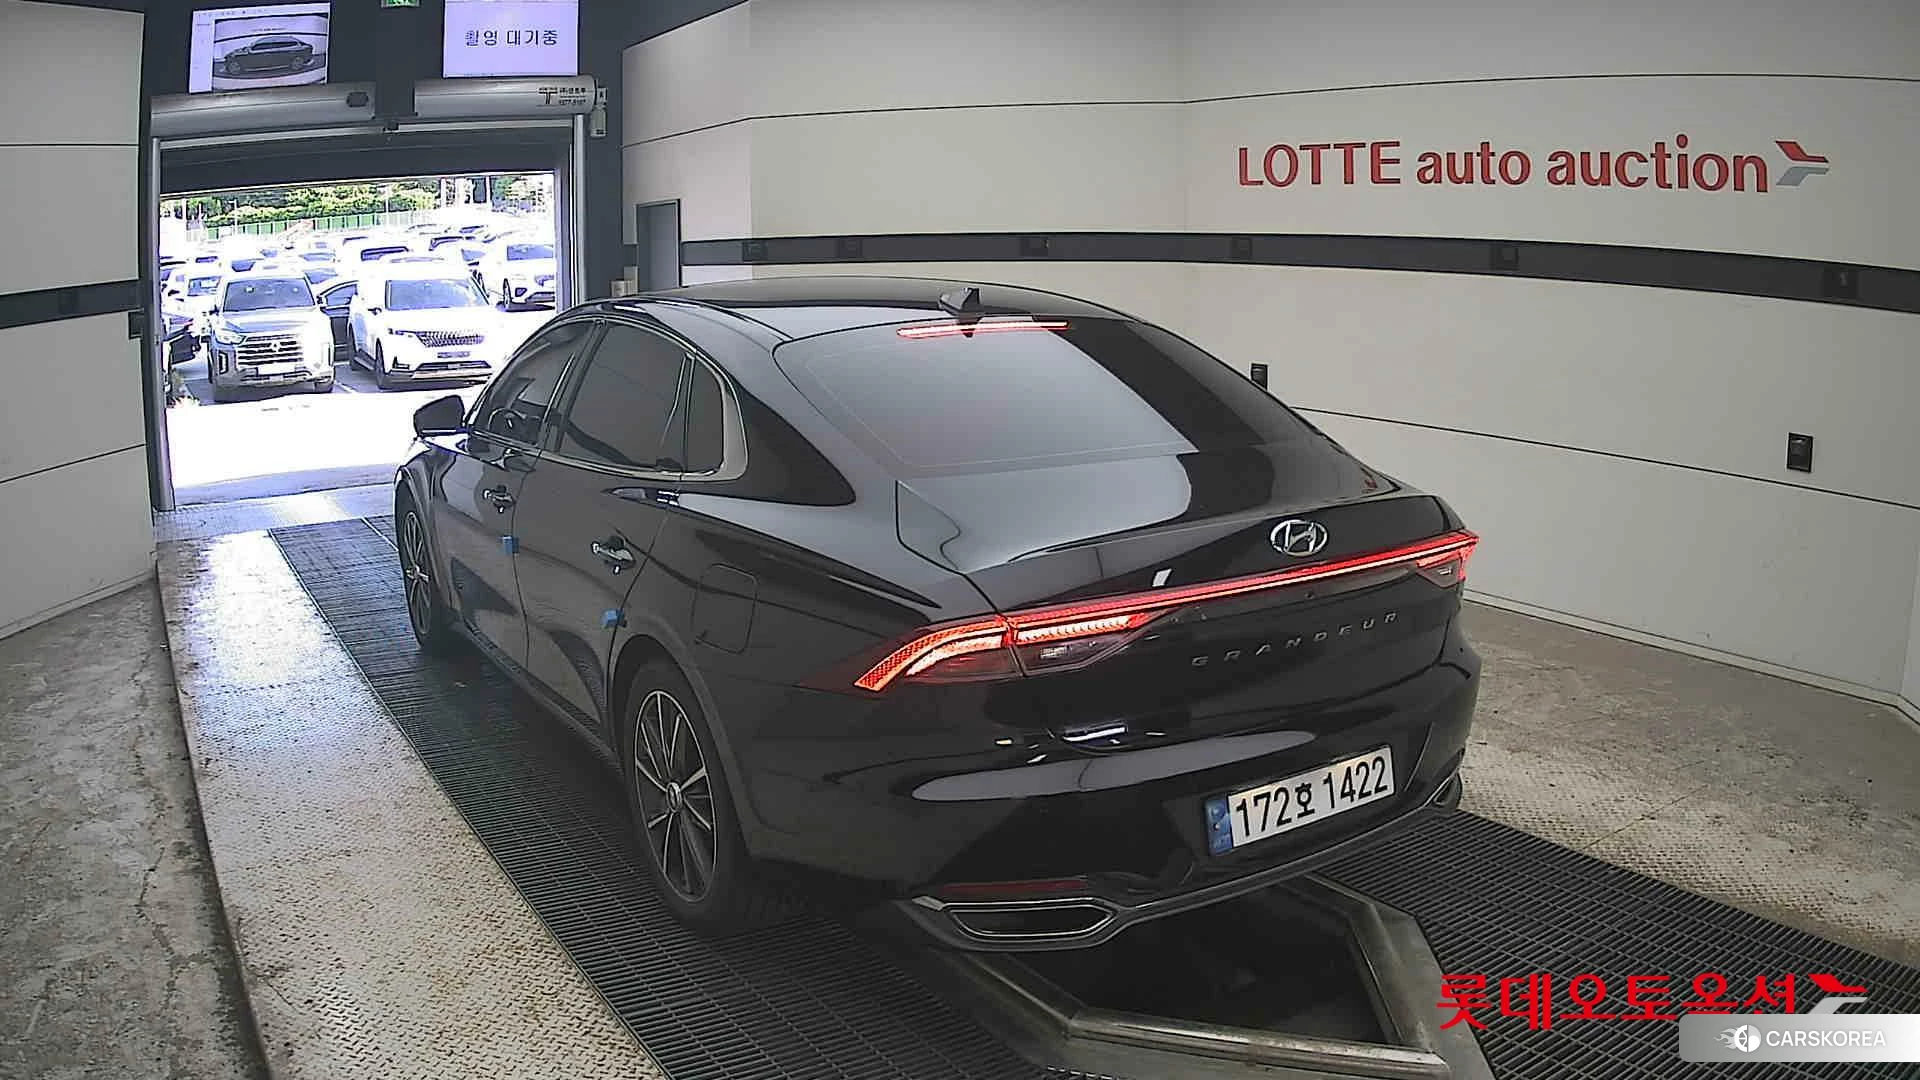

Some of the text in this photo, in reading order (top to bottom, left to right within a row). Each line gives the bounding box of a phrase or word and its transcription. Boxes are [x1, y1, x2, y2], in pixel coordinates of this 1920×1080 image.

[506, 29, 558, 46] 대기중
[1239, 133, 1769, 193] LOTTE auto auction
[1192, 612, 1397, 666] GRANDEUR
[1236, 756, 1388, 836] 172호 1422
